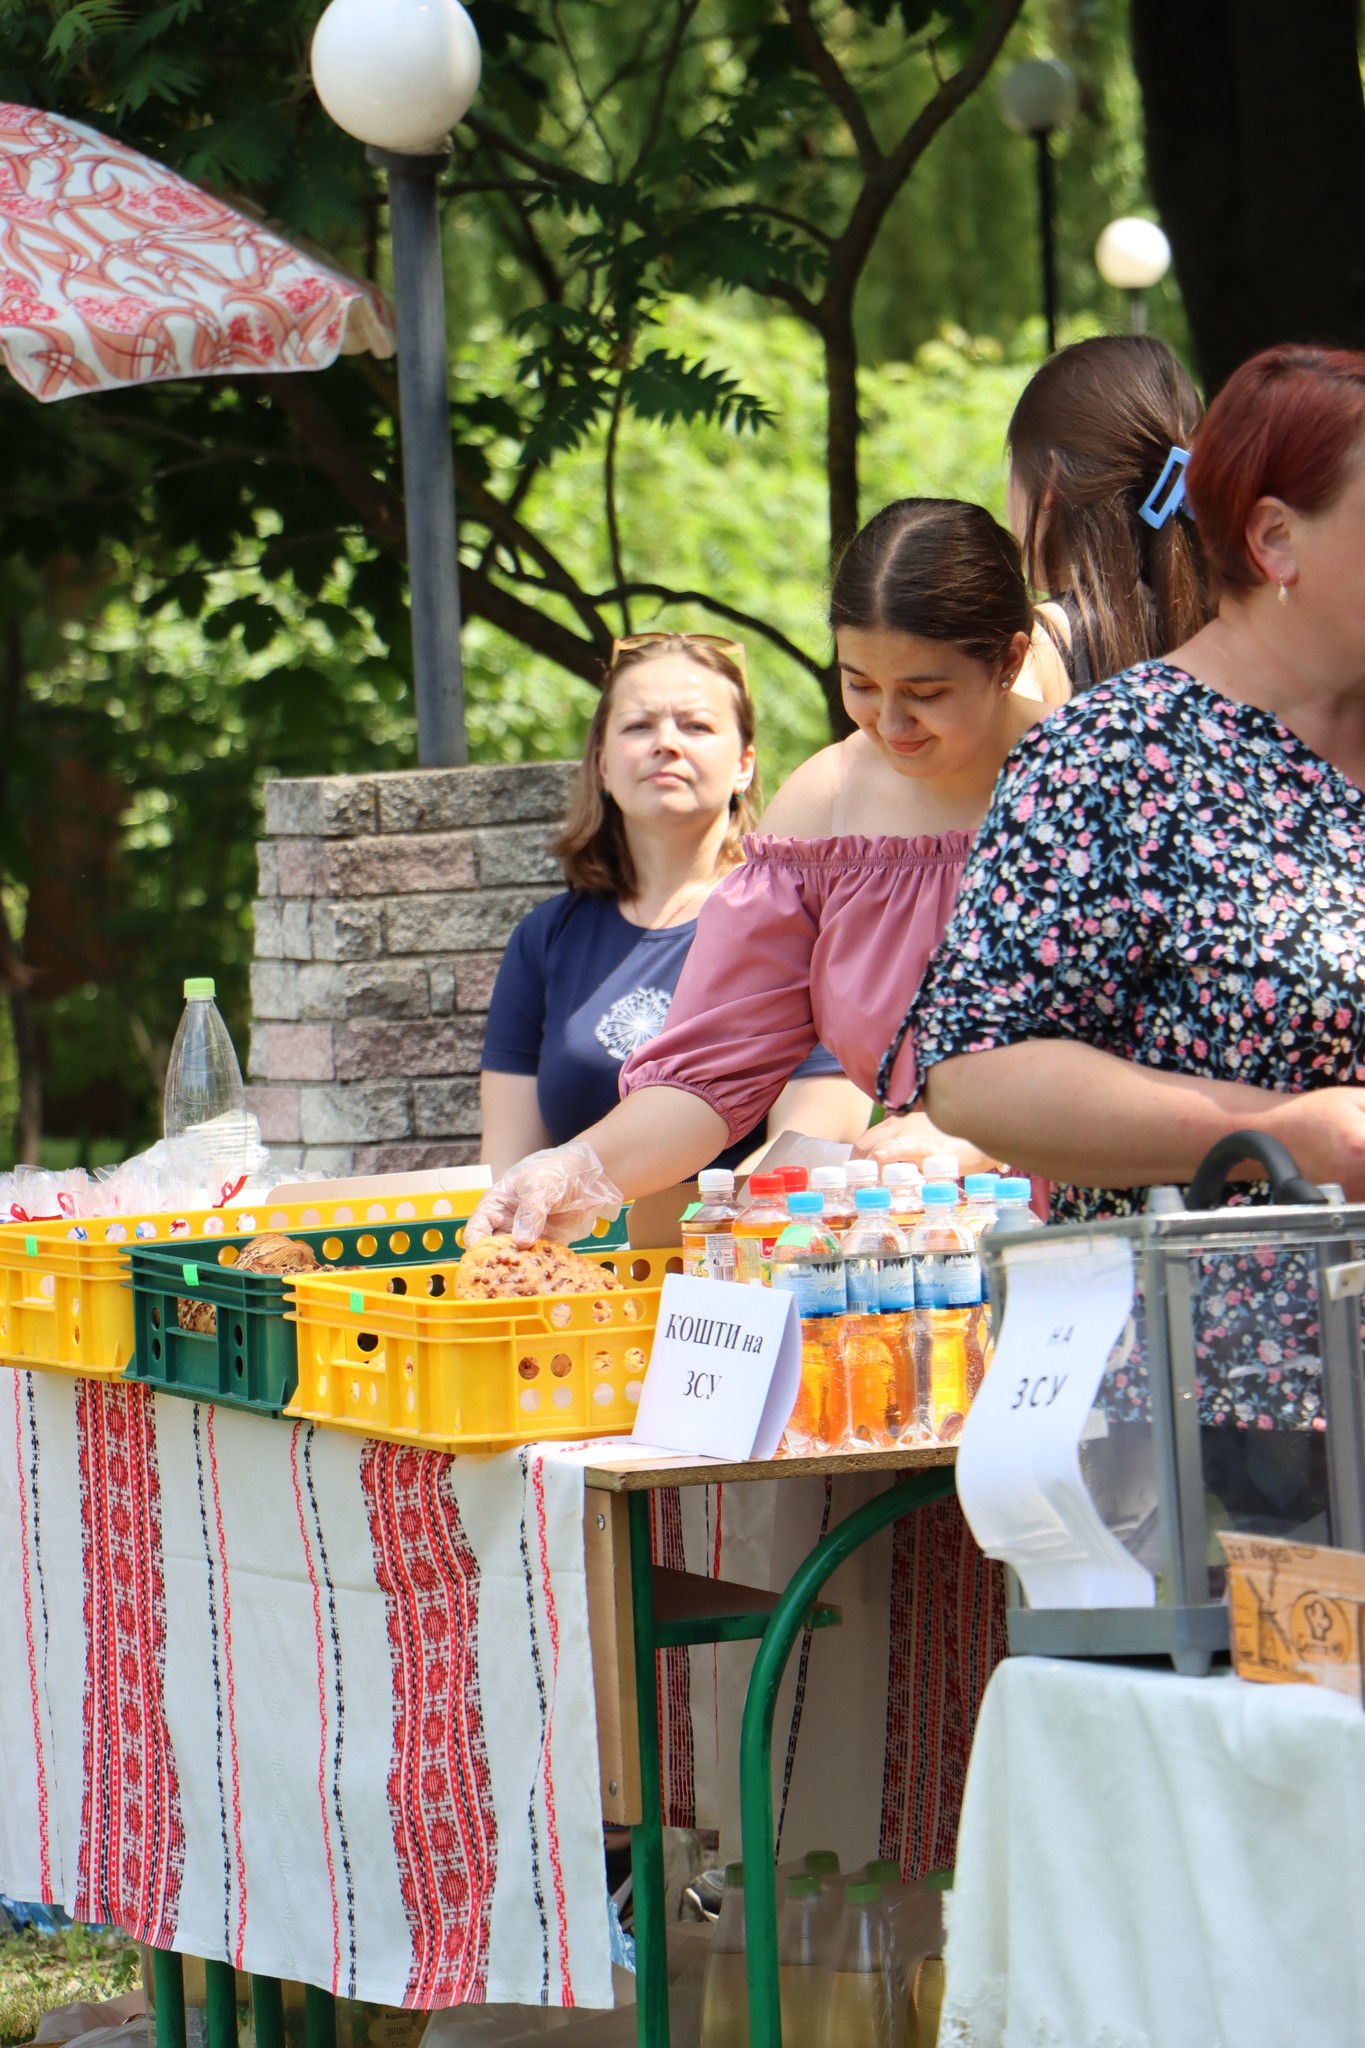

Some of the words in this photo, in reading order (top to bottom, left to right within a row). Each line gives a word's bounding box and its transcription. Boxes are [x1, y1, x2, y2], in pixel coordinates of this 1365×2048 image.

[665, 1314, 743, 1350] КОШТИ
[742, 1334, 764, 1354] на
[683, 1370, 722, 1400] ЗСУ
[1011, 1374, 1069, 1409] ЗСУ
